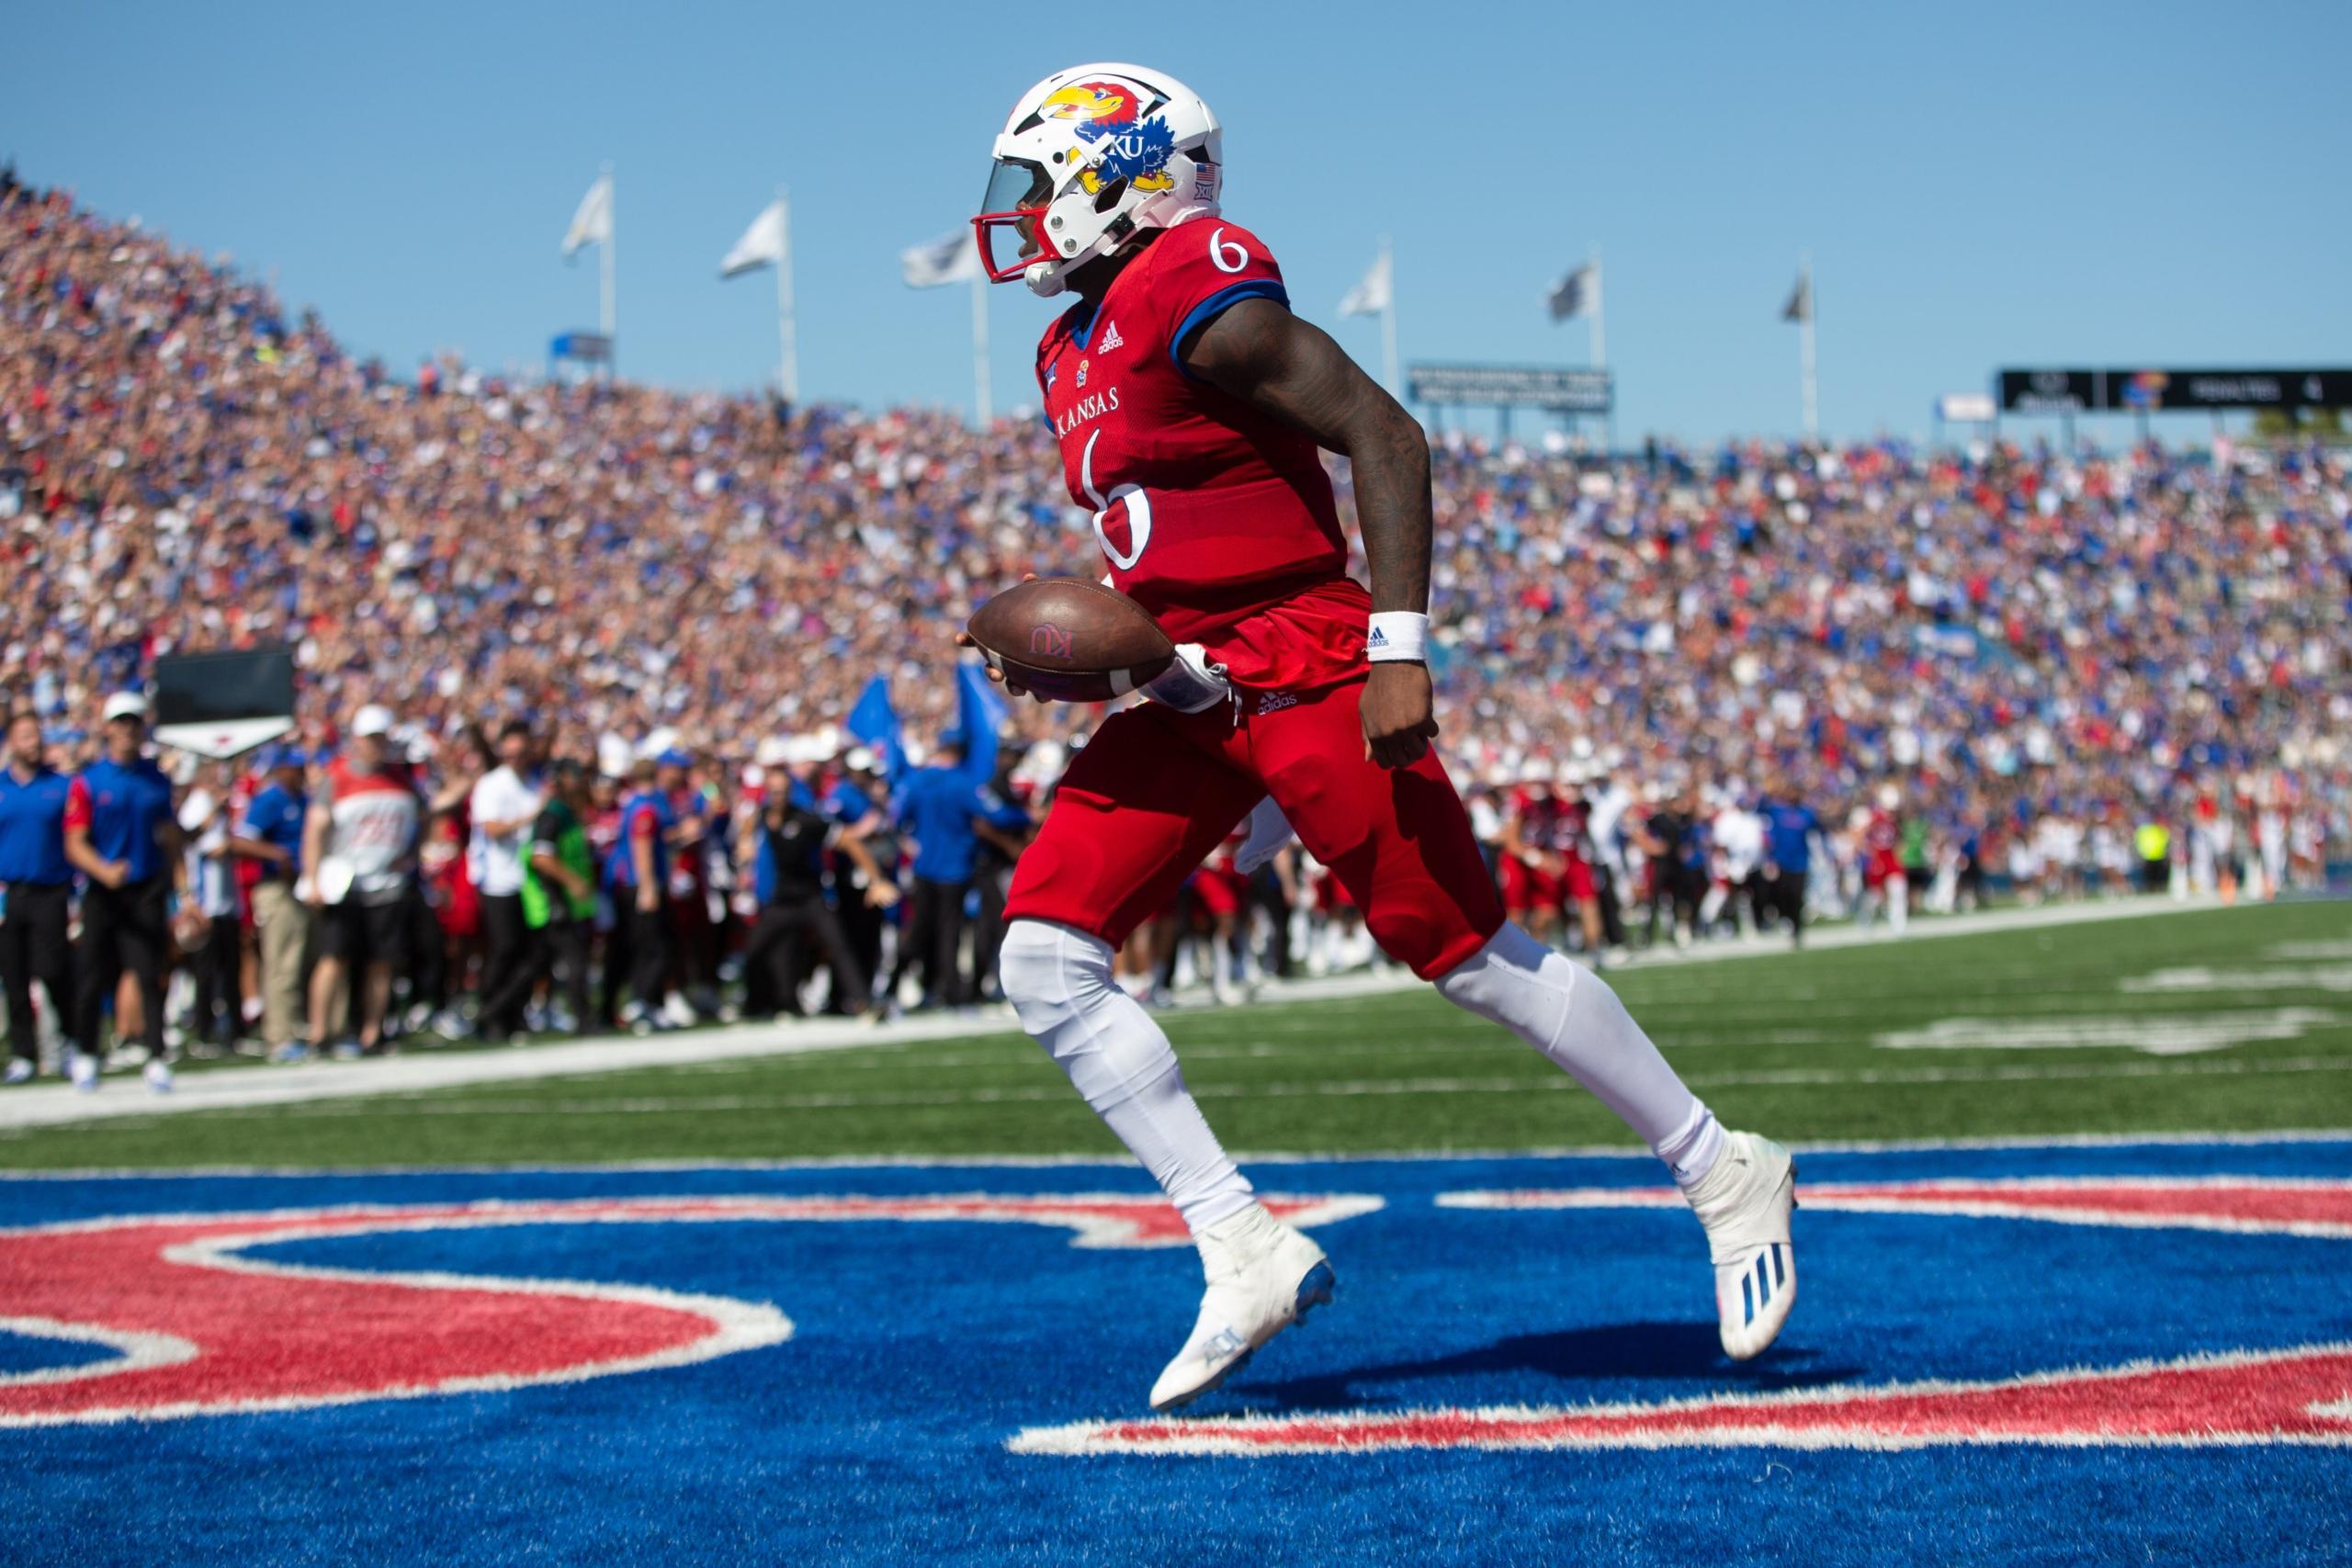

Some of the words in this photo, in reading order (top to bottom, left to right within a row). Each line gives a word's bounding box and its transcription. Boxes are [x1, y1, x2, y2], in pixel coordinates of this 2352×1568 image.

[1107, 134, 1145, 161] KU
[1209, 227, 1249, 273] 6
[1098, 336, 1124, 355] adidas
[1057, 387, 1119, 439] KANSAS
[1081, 426, 1151, 571] 6
[1029, 623, 1074, 659] KU
[1368, 639, 1389, 648] adidas
[1258, 694, 1297, 716] adidas
